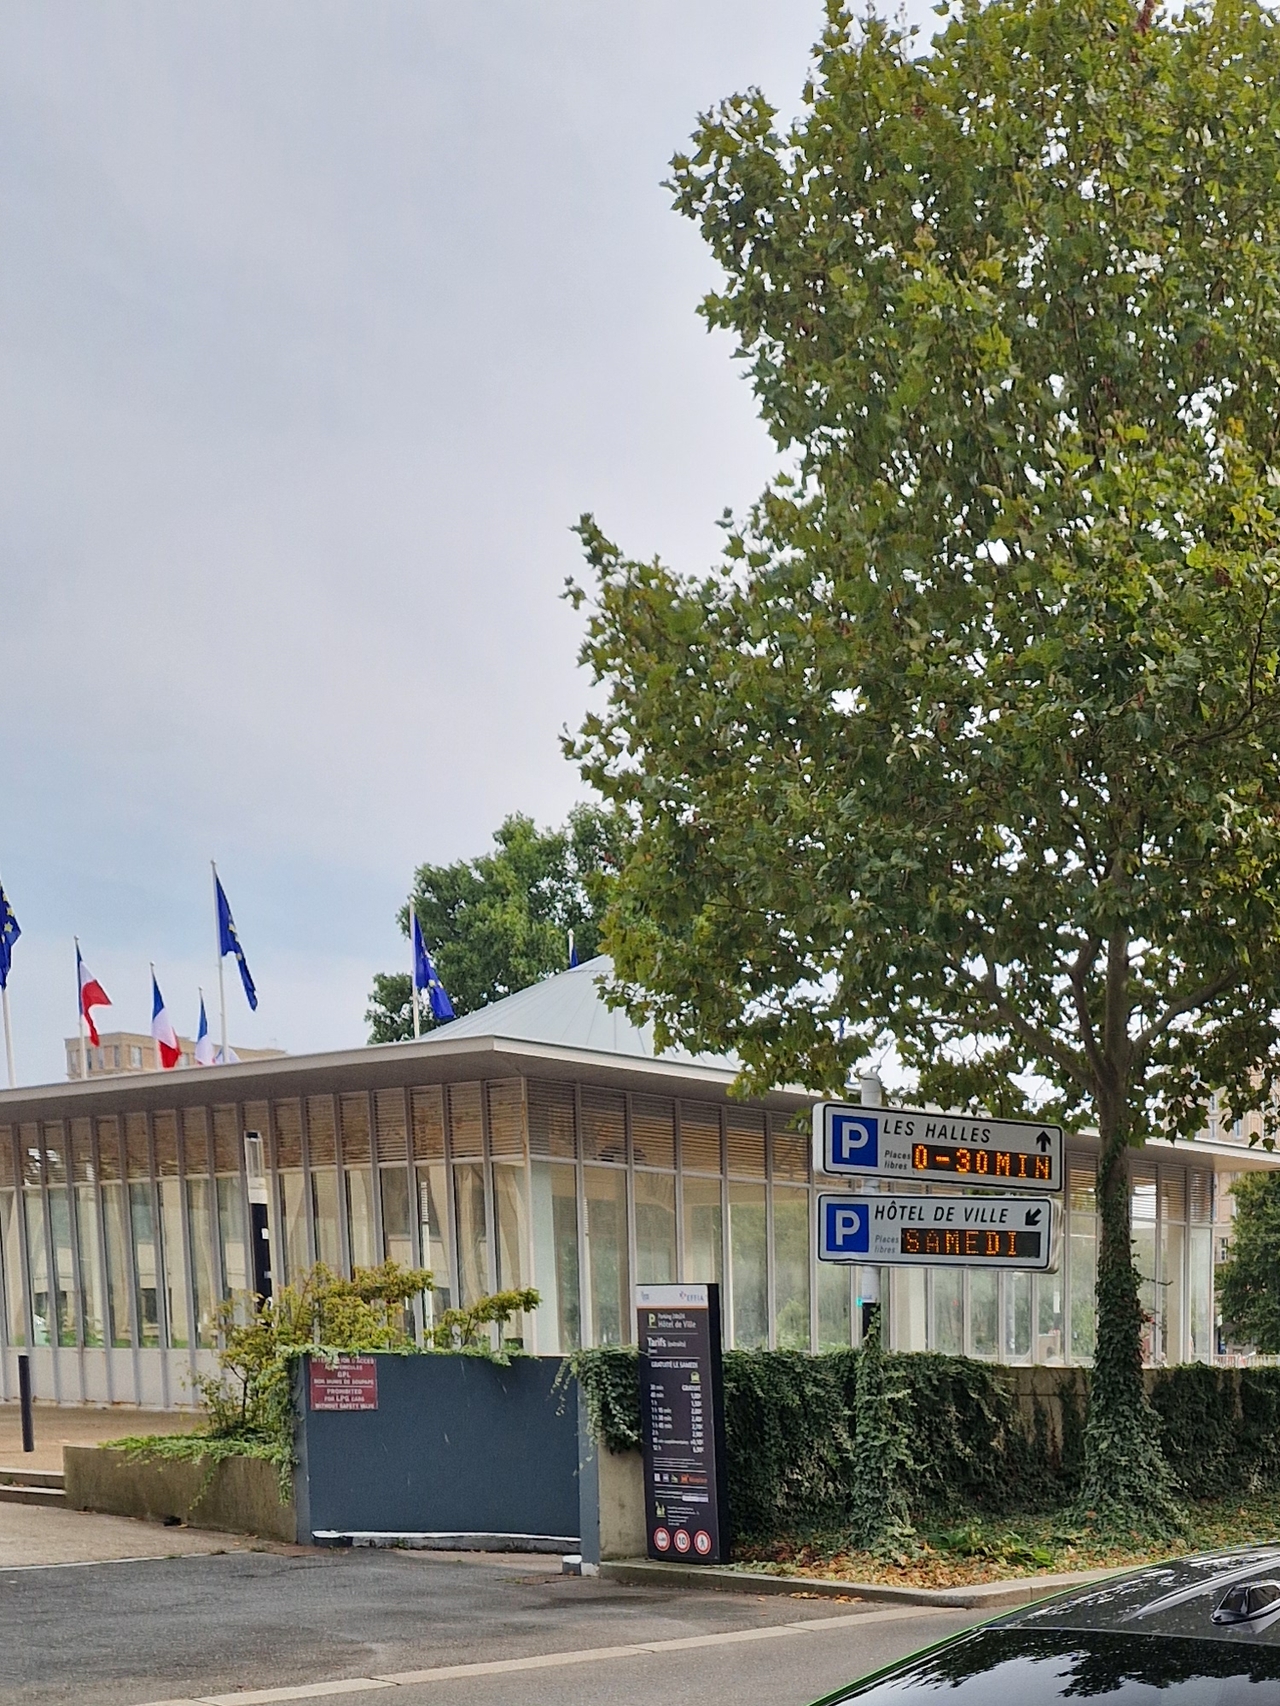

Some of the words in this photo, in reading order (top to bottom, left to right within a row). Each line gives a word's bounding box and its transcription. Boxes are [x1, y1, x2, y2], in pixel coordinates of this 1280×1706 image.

[841, 1121, 869, 1159] P
[883, 1118, 915, 1136] LES
[925, 1122, 991, 1144] HALLES
[884, 1149, 911, 1162] Places
[884, 1159, 908, 1171] libres
[874, 1200, 925, 1221] HÔTEL
[933, 1206, 955, 1222] DE
[964, 1207, 1009, 1224] VILLE
[835, 1209, 861, 1246] P
[904, 1229, 1017, 1258] SAMEDI
[658, 1320, 674, 1328] Hôtel
[682, 1320, 697, 1328] Ville
[647, 1337, 667, 1348] Tarifs
